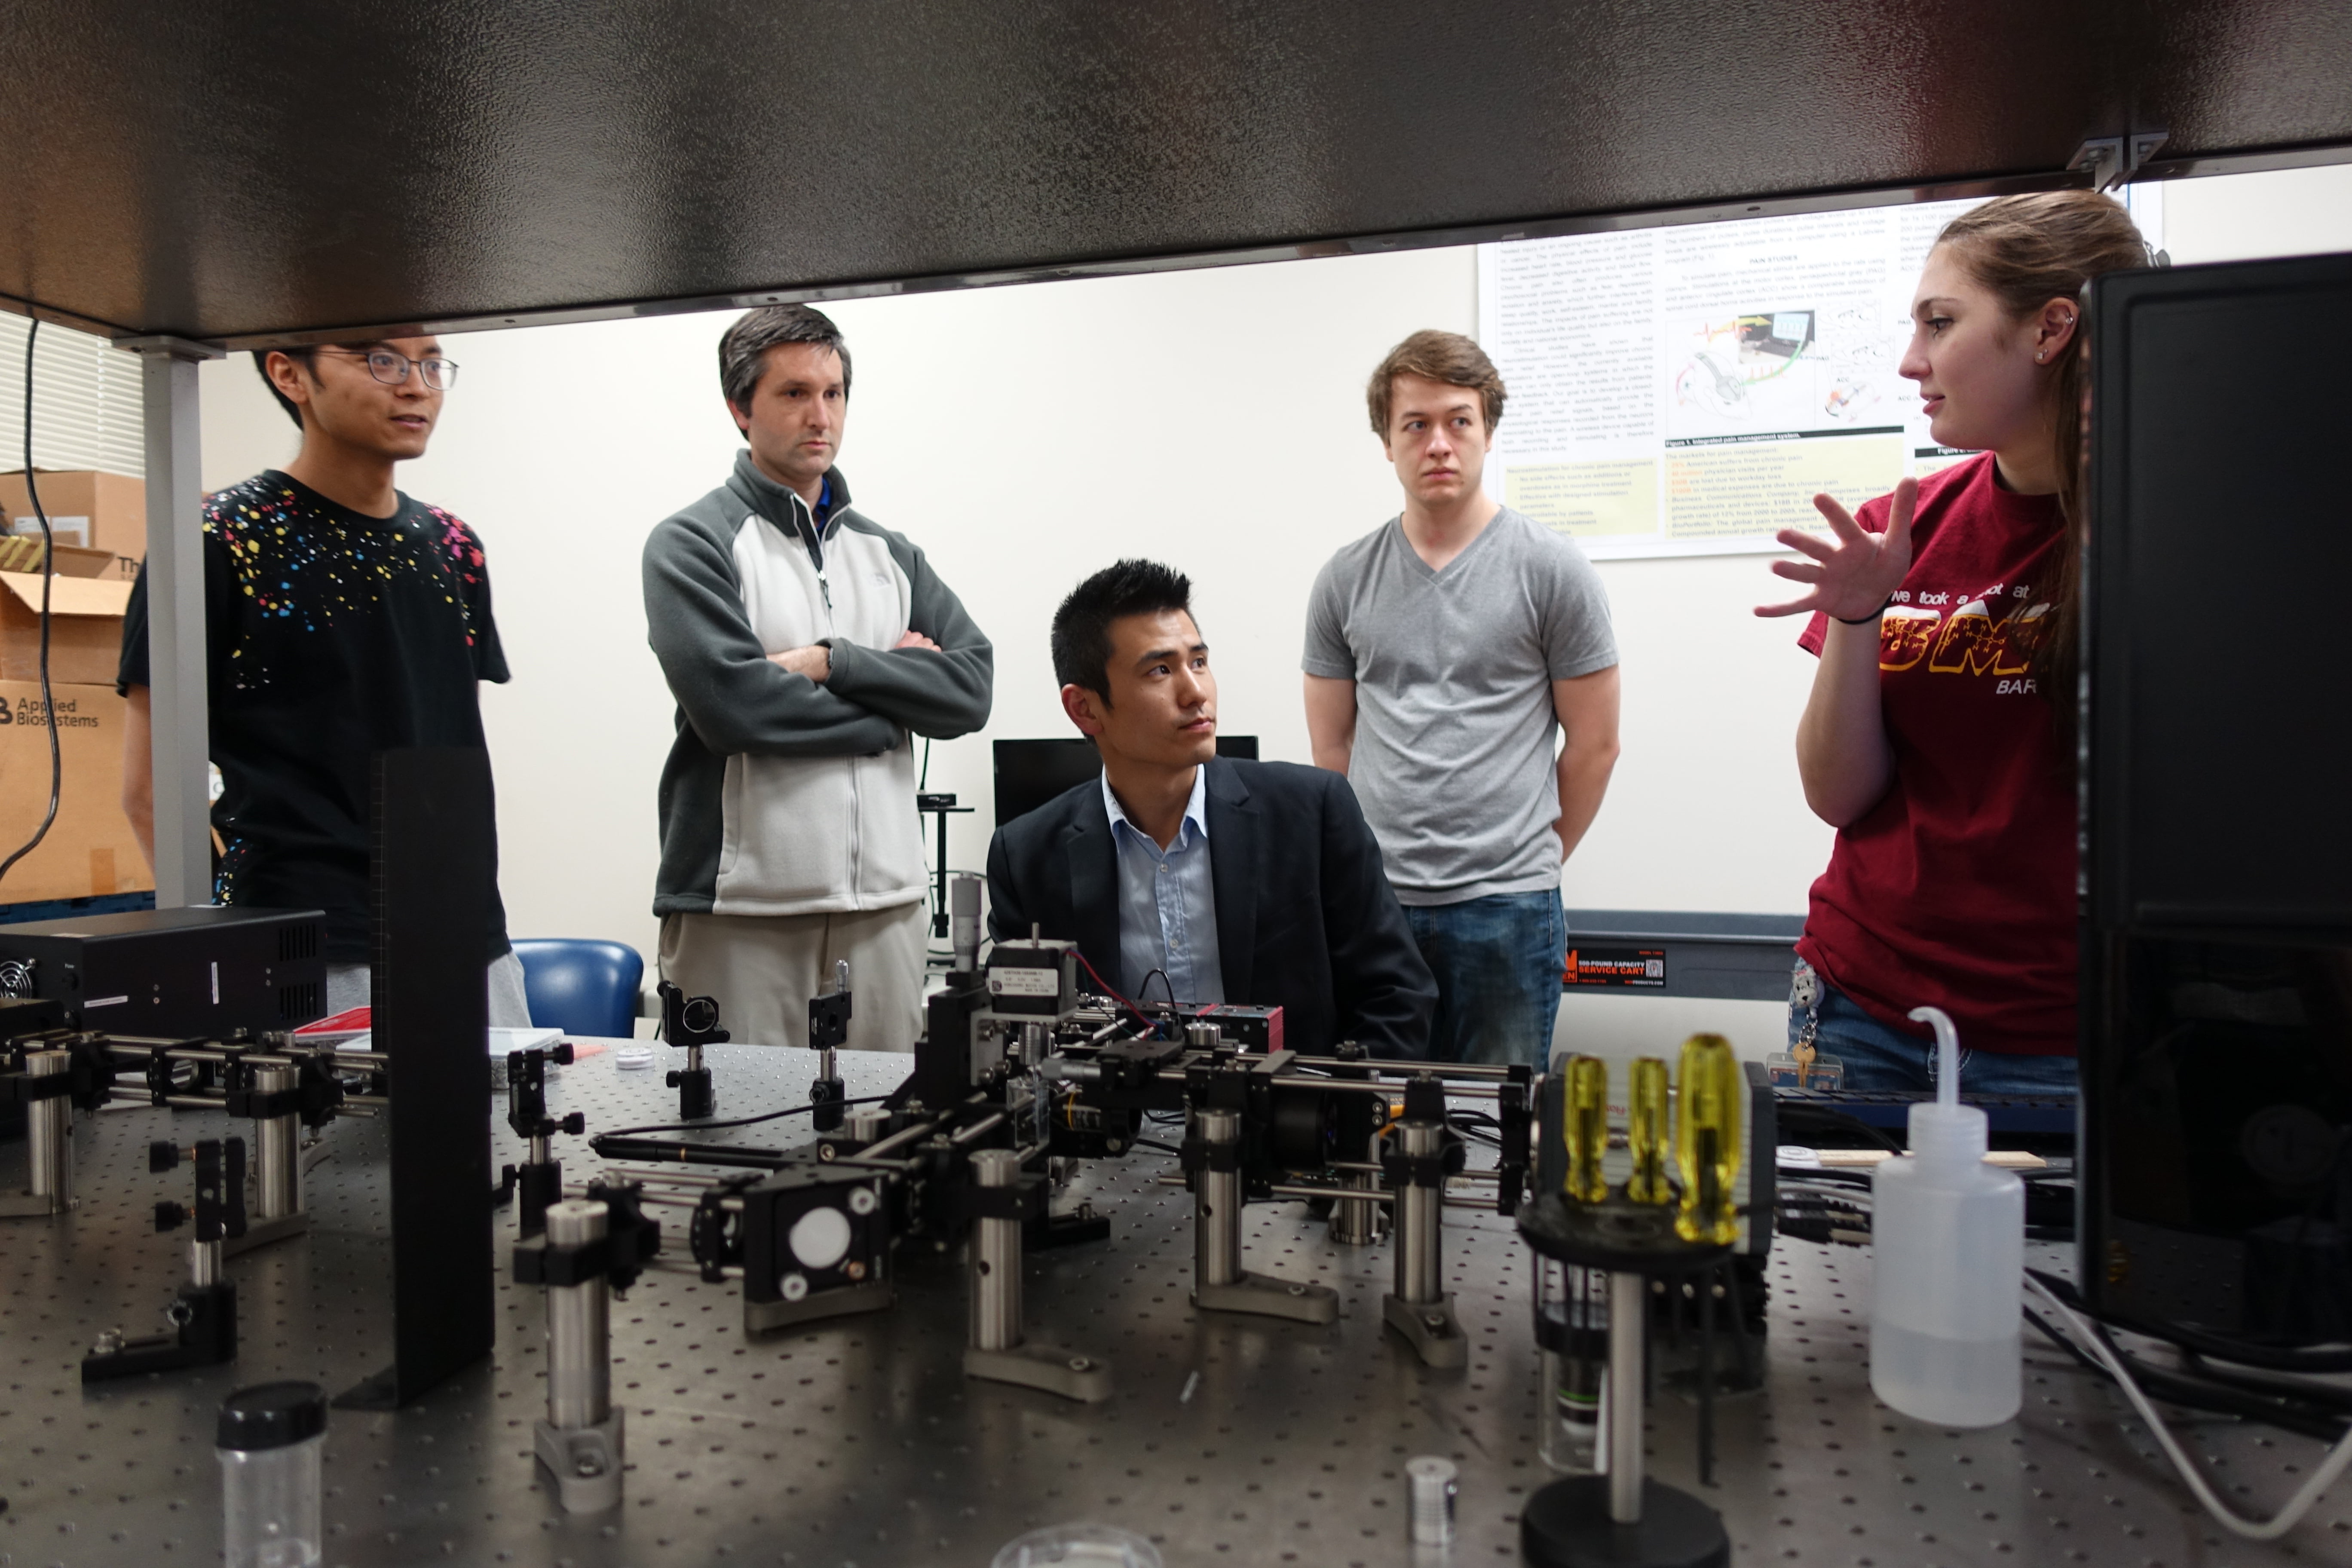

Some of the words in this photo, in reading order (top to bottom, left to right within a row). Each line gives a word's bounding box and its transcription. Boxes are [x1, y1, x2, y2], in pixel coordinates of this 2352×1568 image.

[1737, 434, 1776, 442] management
[1937, 447, 1958, 456] Figure
[1788, 454, 1802, 462] pain
[1612, 460, 1653, 469] management
[1823, 479, 1838, 487] pain
[1755, 517, 1770, 525] pain
[1773, 515, 1817, 524] management
[1919, 591, 1949, 605] took
[1957, 594, 1969, 605] a
[2013, 585, 2030, 598] at
[17, 712, 99, 727] Biosstems
[1579, 966, 1618, 974] SERVICE
[1620, 967, 1645, 975] CART
